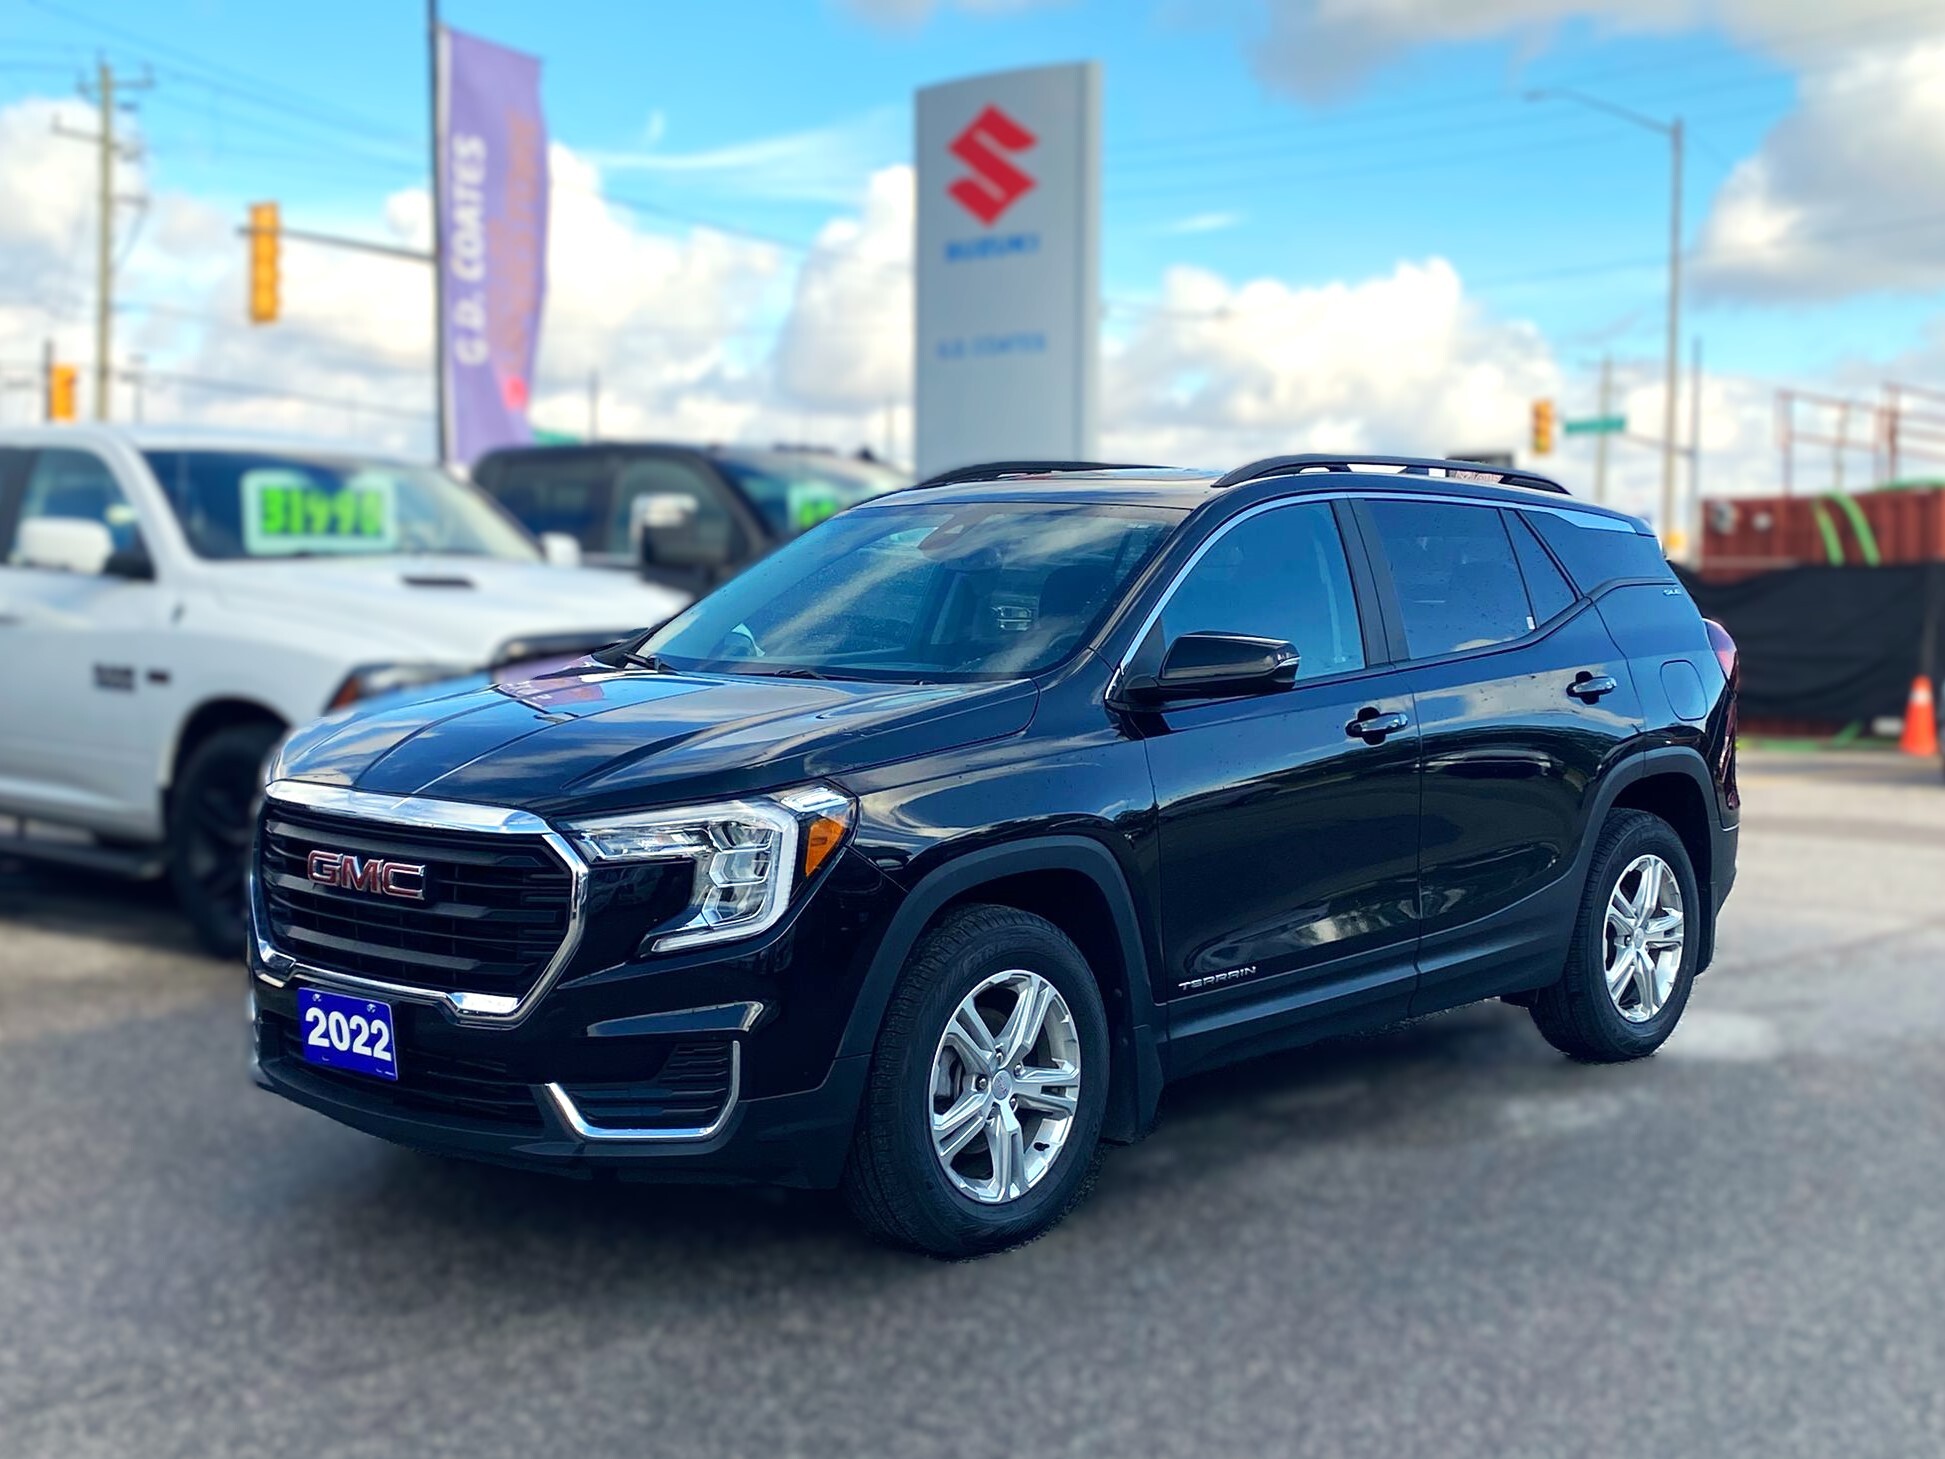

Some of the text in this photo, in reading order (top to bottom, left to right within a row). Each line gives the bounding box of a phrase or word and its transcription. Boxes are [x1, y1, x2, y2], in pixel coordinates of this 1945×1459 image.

[451, 132, 487, 283] COATES
[307, 850, 426, 900] GMC
[1178, 966, 1257, 991] TERRAIN
[305, 1006, 392, 1062] 2022
